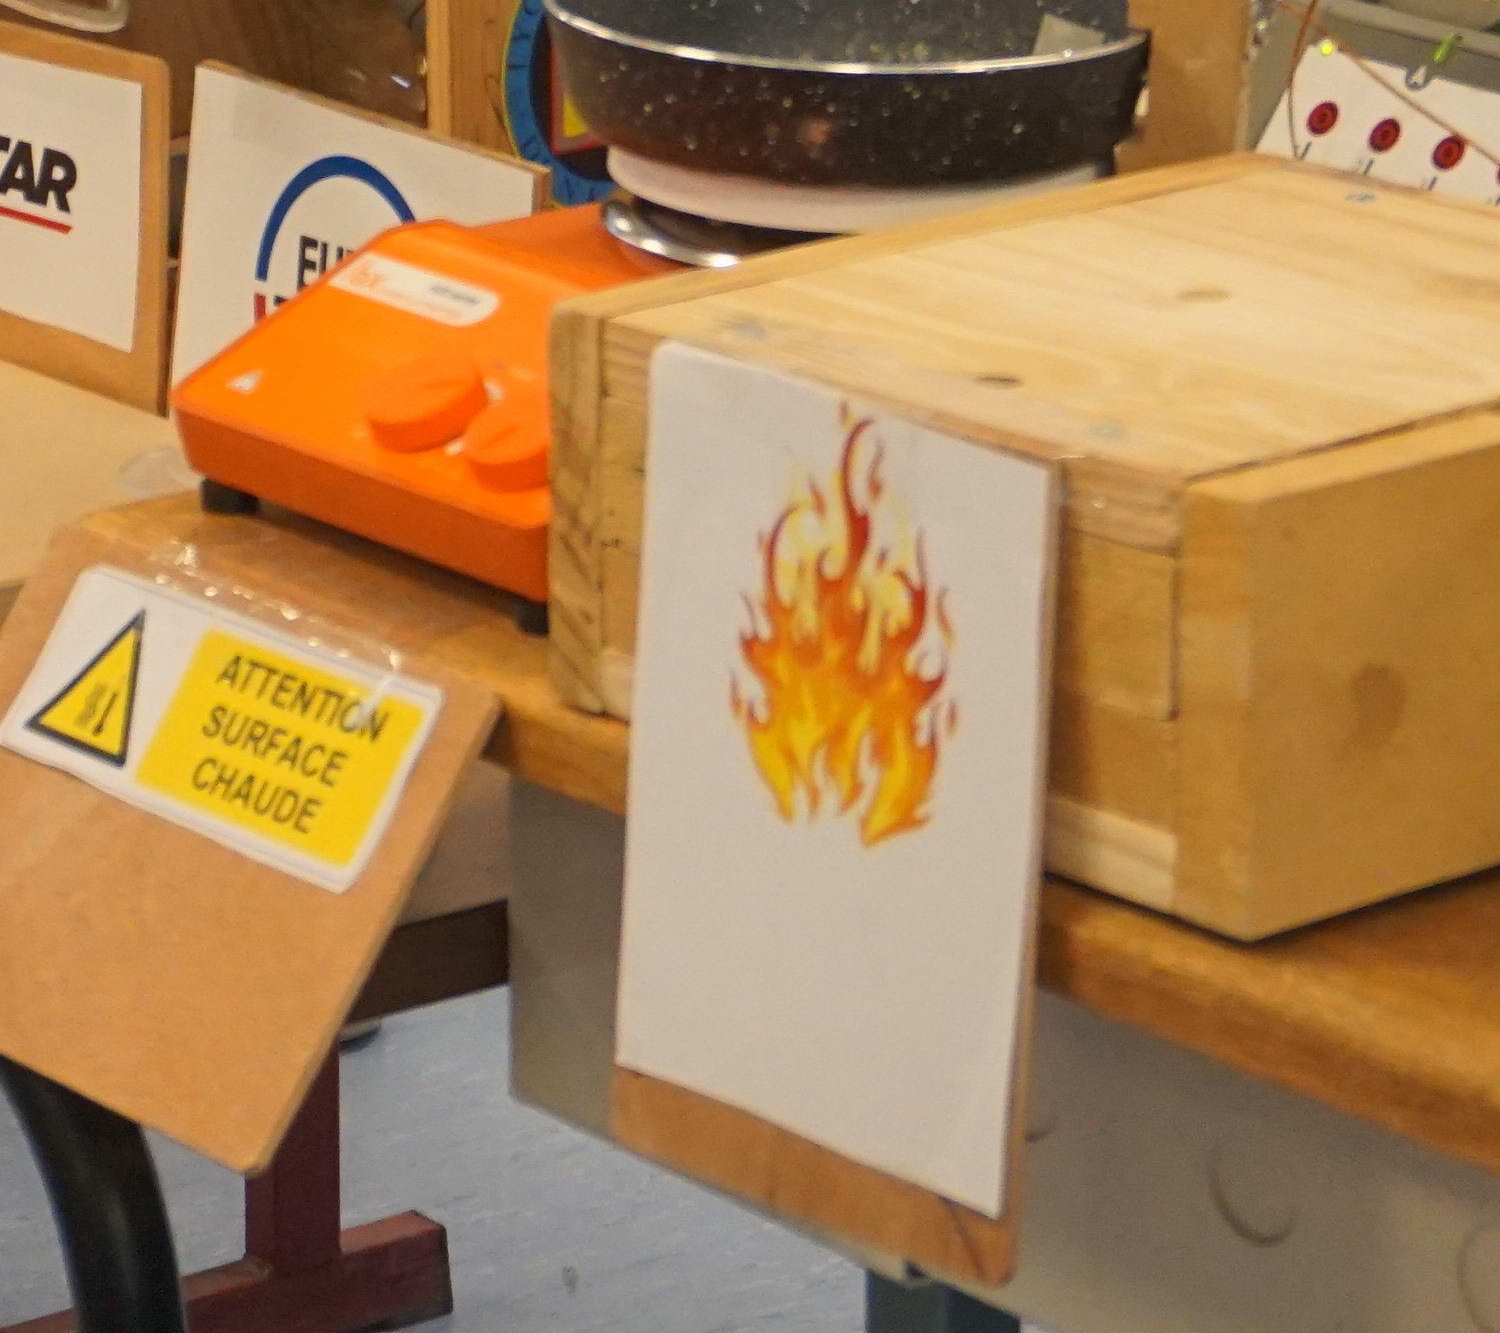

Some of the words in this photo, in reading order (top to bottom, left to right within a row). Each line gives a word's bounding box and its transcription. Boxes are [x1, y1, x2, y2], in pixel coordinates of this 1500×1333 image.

[215, 654, 391, 745] ATTENTION
[202, 705, 349, 787] SURFACE
[191, 757, 323, 835] CHAUDE
